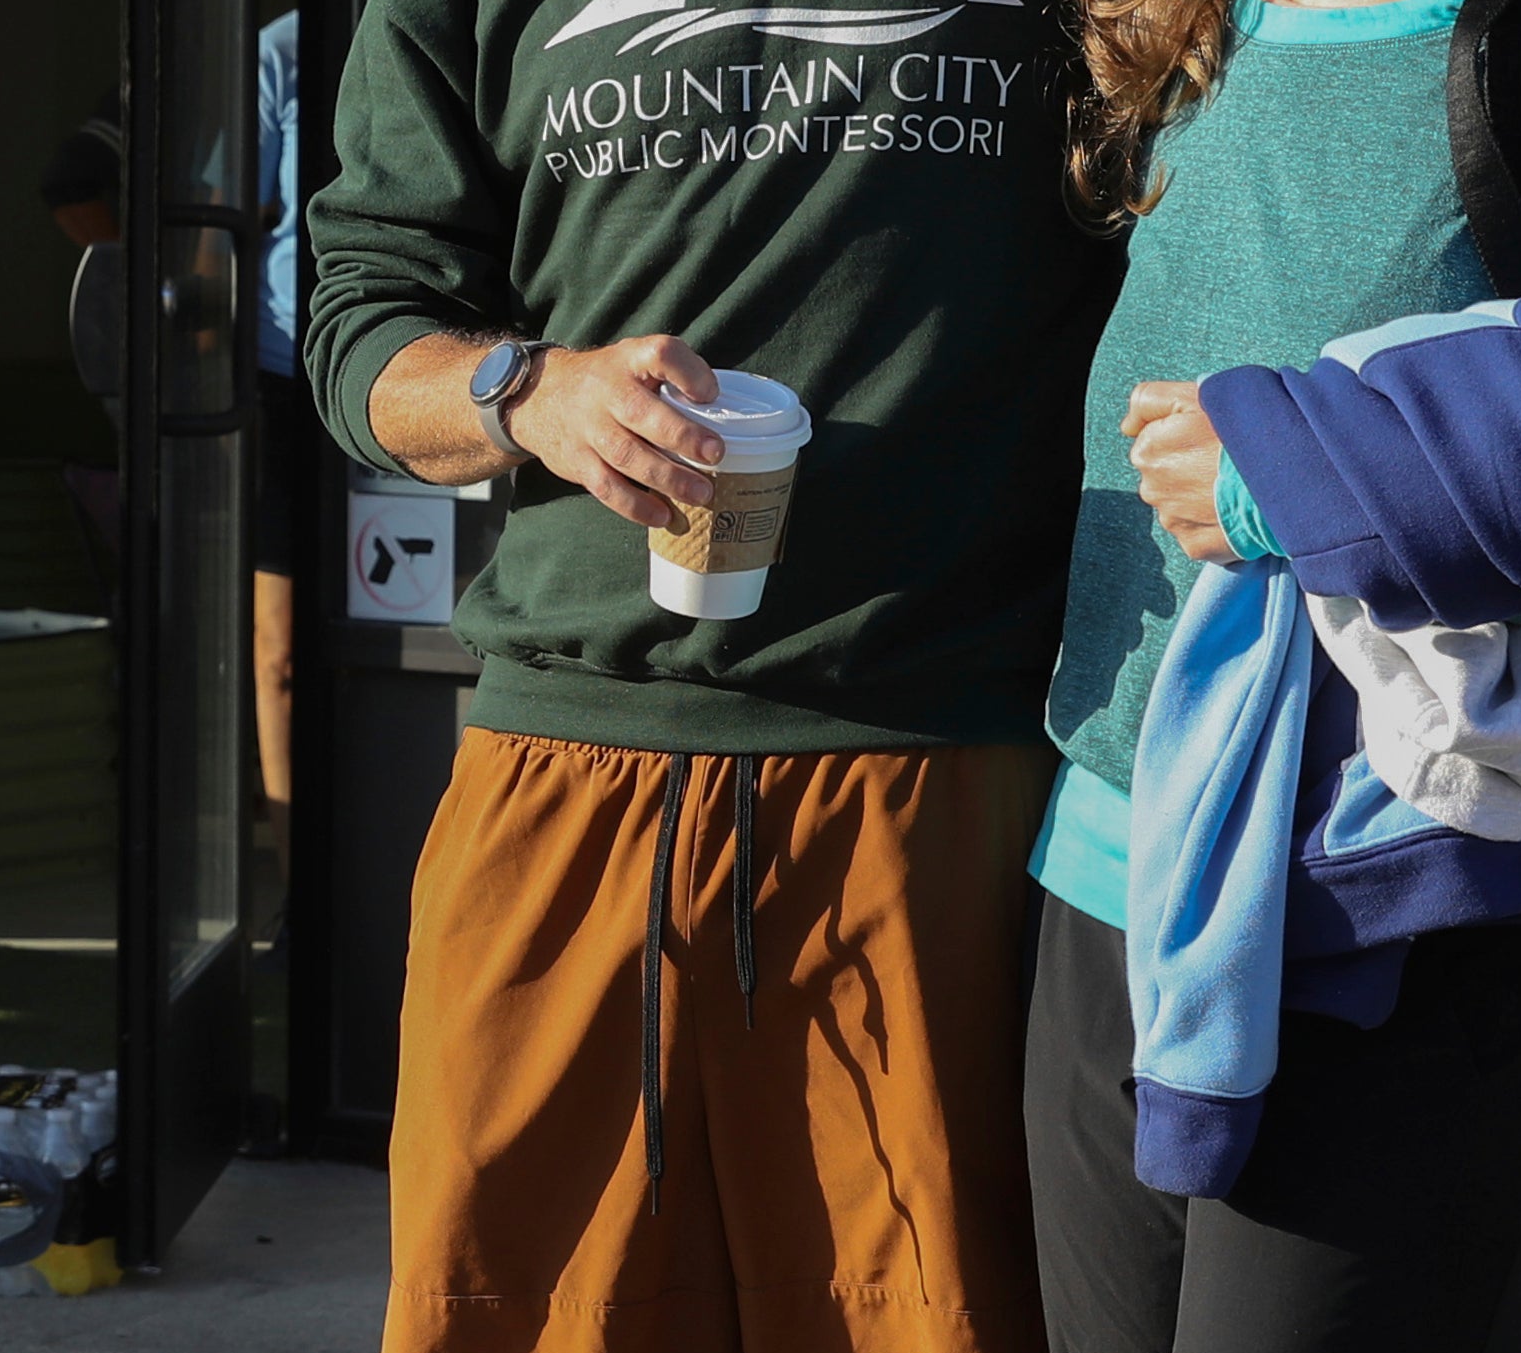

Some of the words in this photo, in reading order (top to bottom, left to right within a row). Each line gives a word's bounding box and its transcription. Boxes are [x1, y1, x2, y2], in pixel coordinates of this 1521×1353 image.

[542, 55, 864, 141] MOUNTAIN
[889, 53, 1023, 108] CITY
[544, 130, 685, 183] PUBLIC
[701, 114, 1004, 164] MONTESSORI
